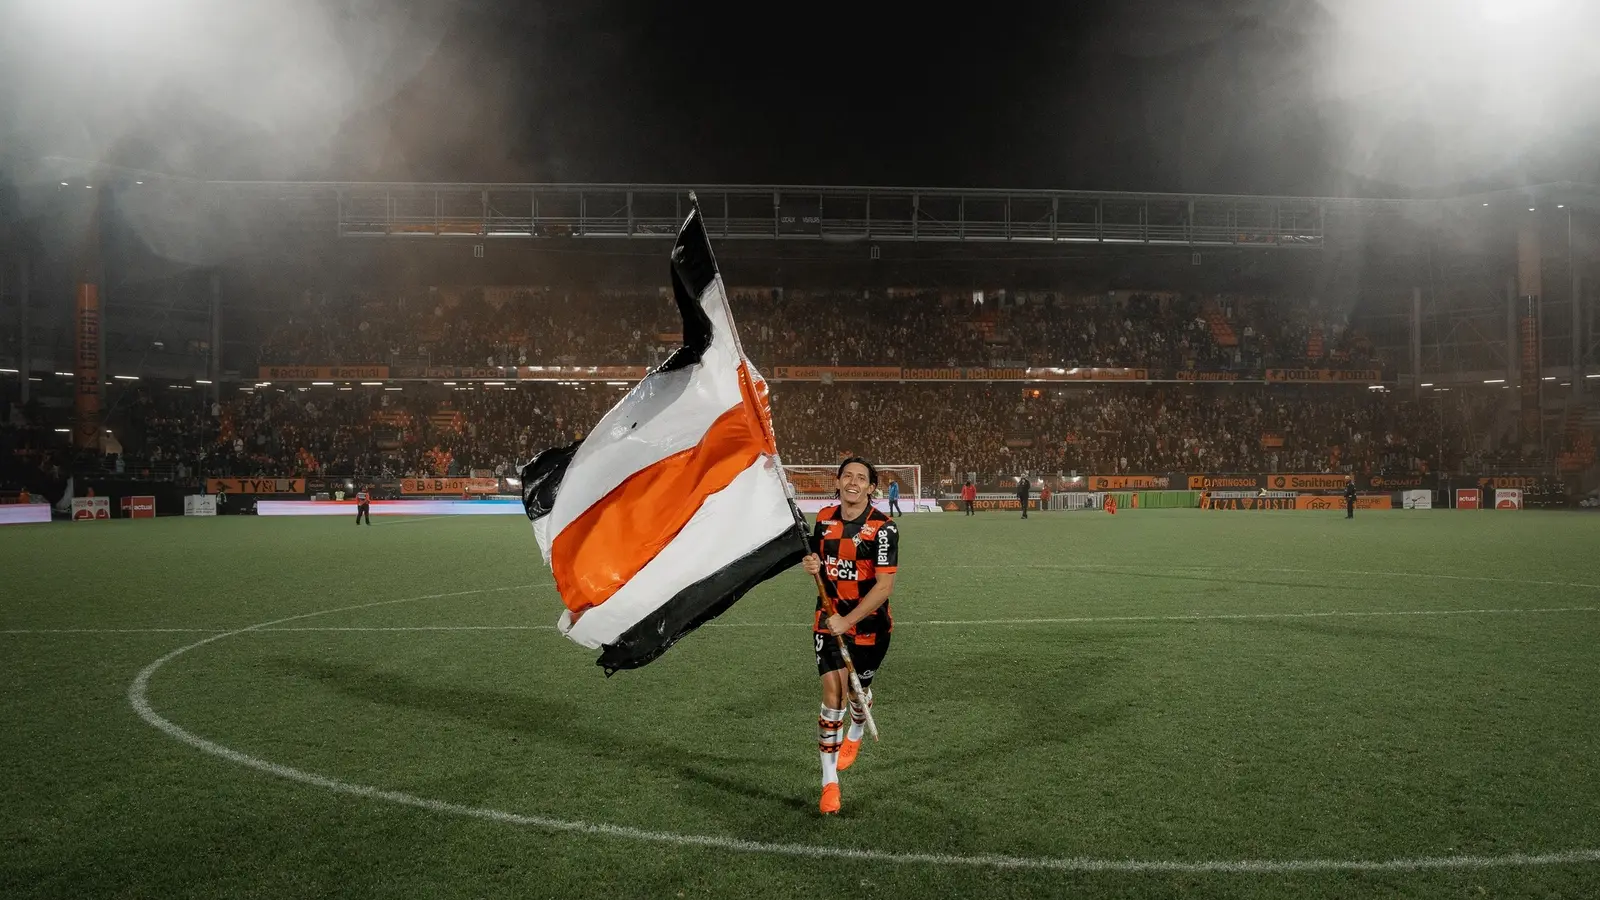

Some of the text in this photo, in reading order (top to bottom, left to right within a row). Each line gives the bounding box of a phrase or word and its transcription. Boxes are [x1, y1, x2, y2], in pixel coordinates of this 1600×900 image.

[280, 367, 379, 379] actual actual
[421, 367, 454, 378] JEAN
[462, 367, 507, 378] FLOCH
[903, 368, 1024, 379] ACADOMIA ACADOMIA
[1291, 477, 1346, 488] Sanitherm
[877, 530, 890, 566] actual
[824, 555, 853, 569] JEAN
[826, 566, 859, 581] LOC'H
